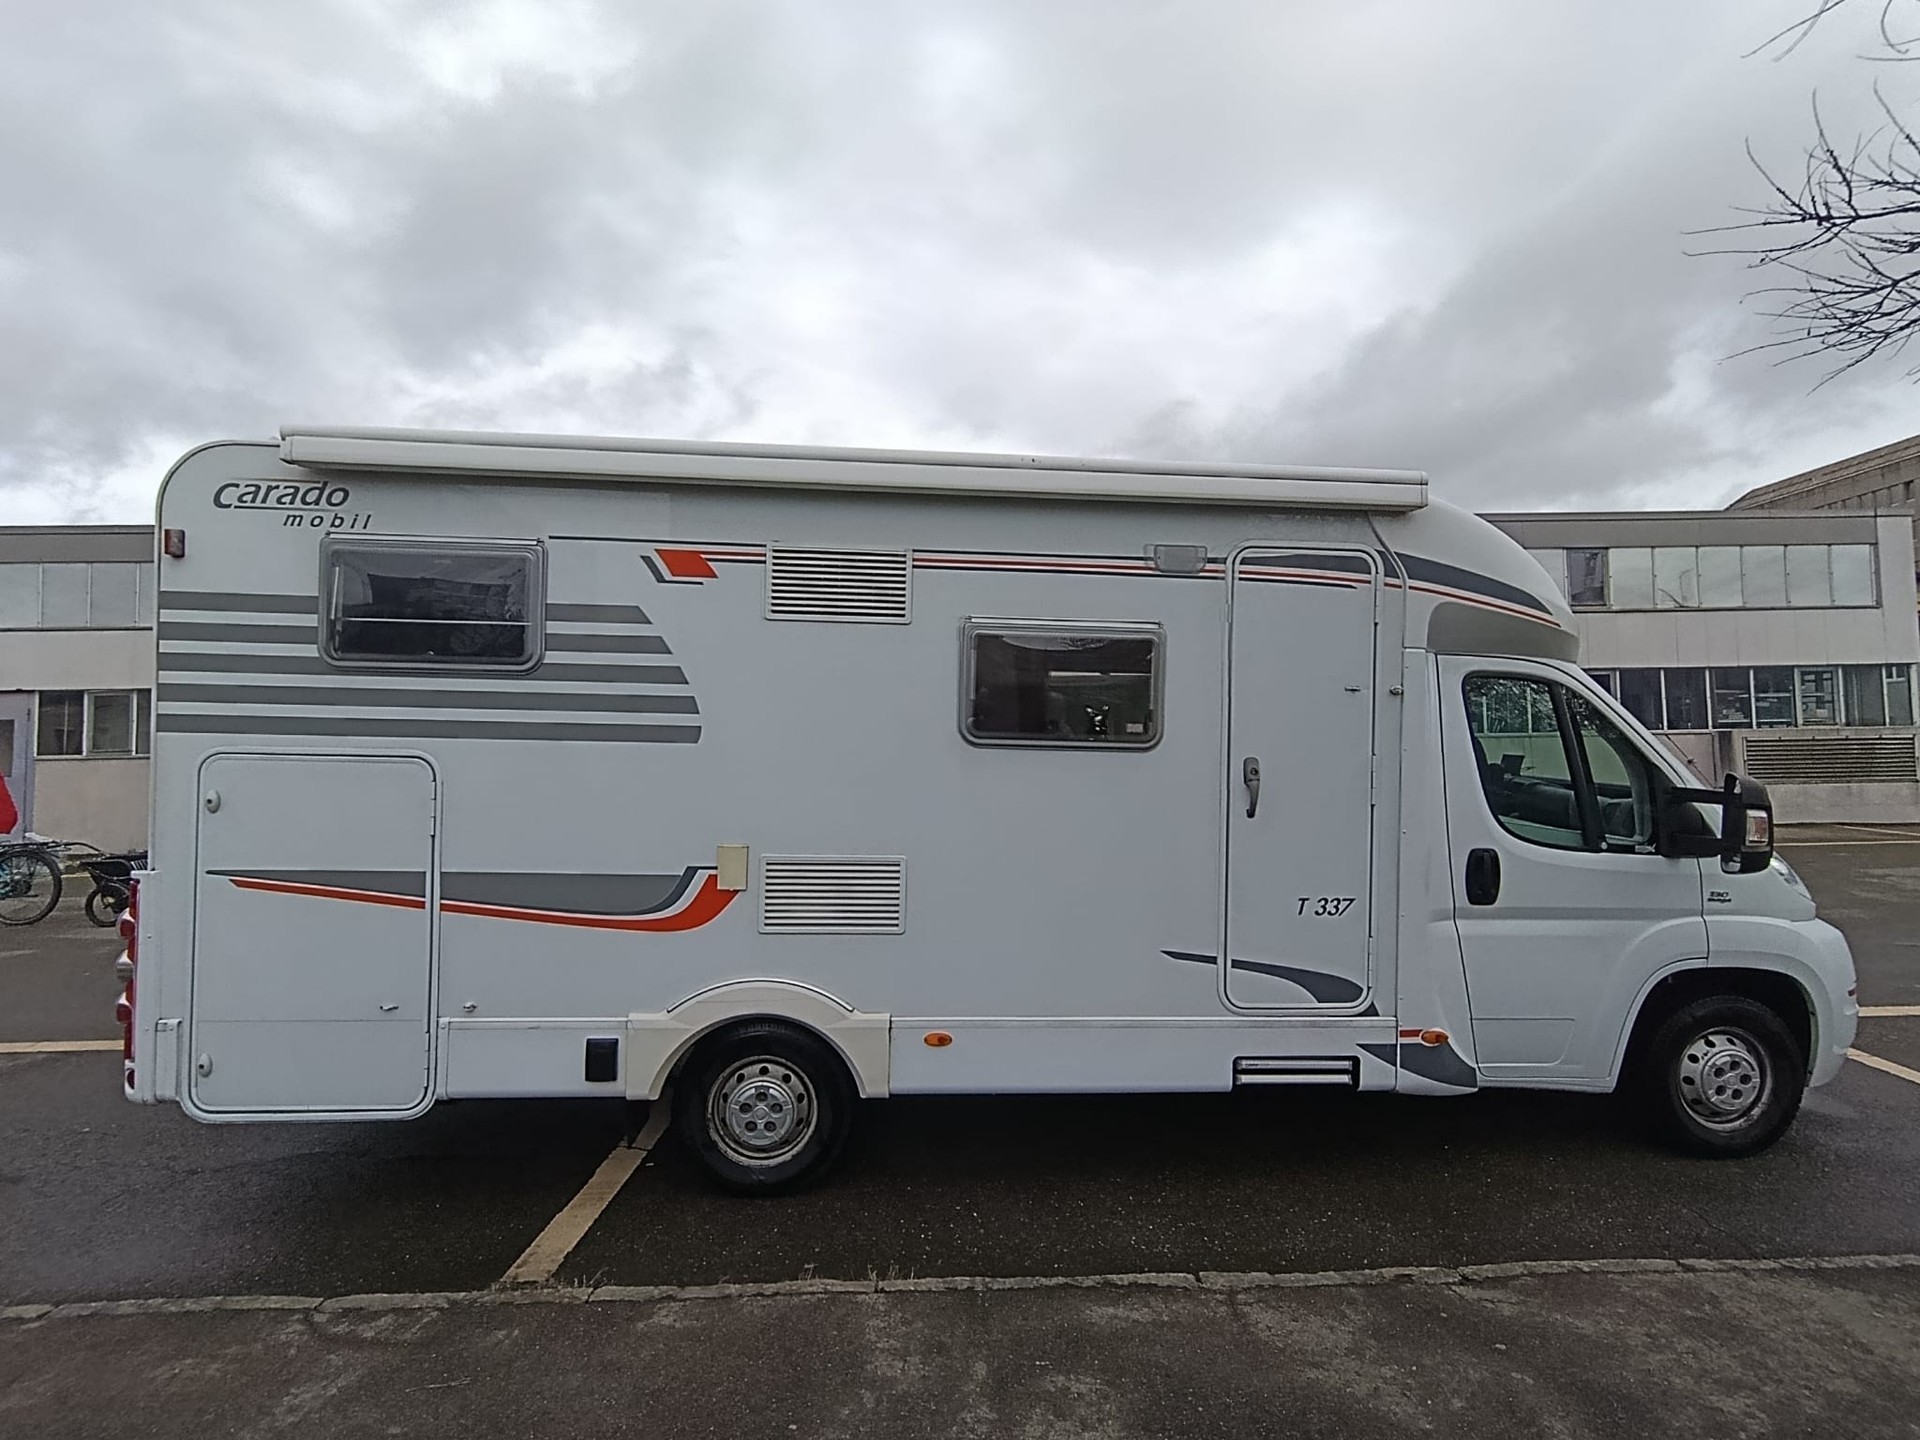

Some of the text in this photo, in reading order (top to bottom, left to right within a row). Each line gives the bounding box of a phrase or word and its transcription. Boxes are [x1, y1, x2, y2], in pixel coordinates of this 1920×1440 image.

[283, 513, 372, 530] mobil
[1298, 897, 1357, 917] T 337
